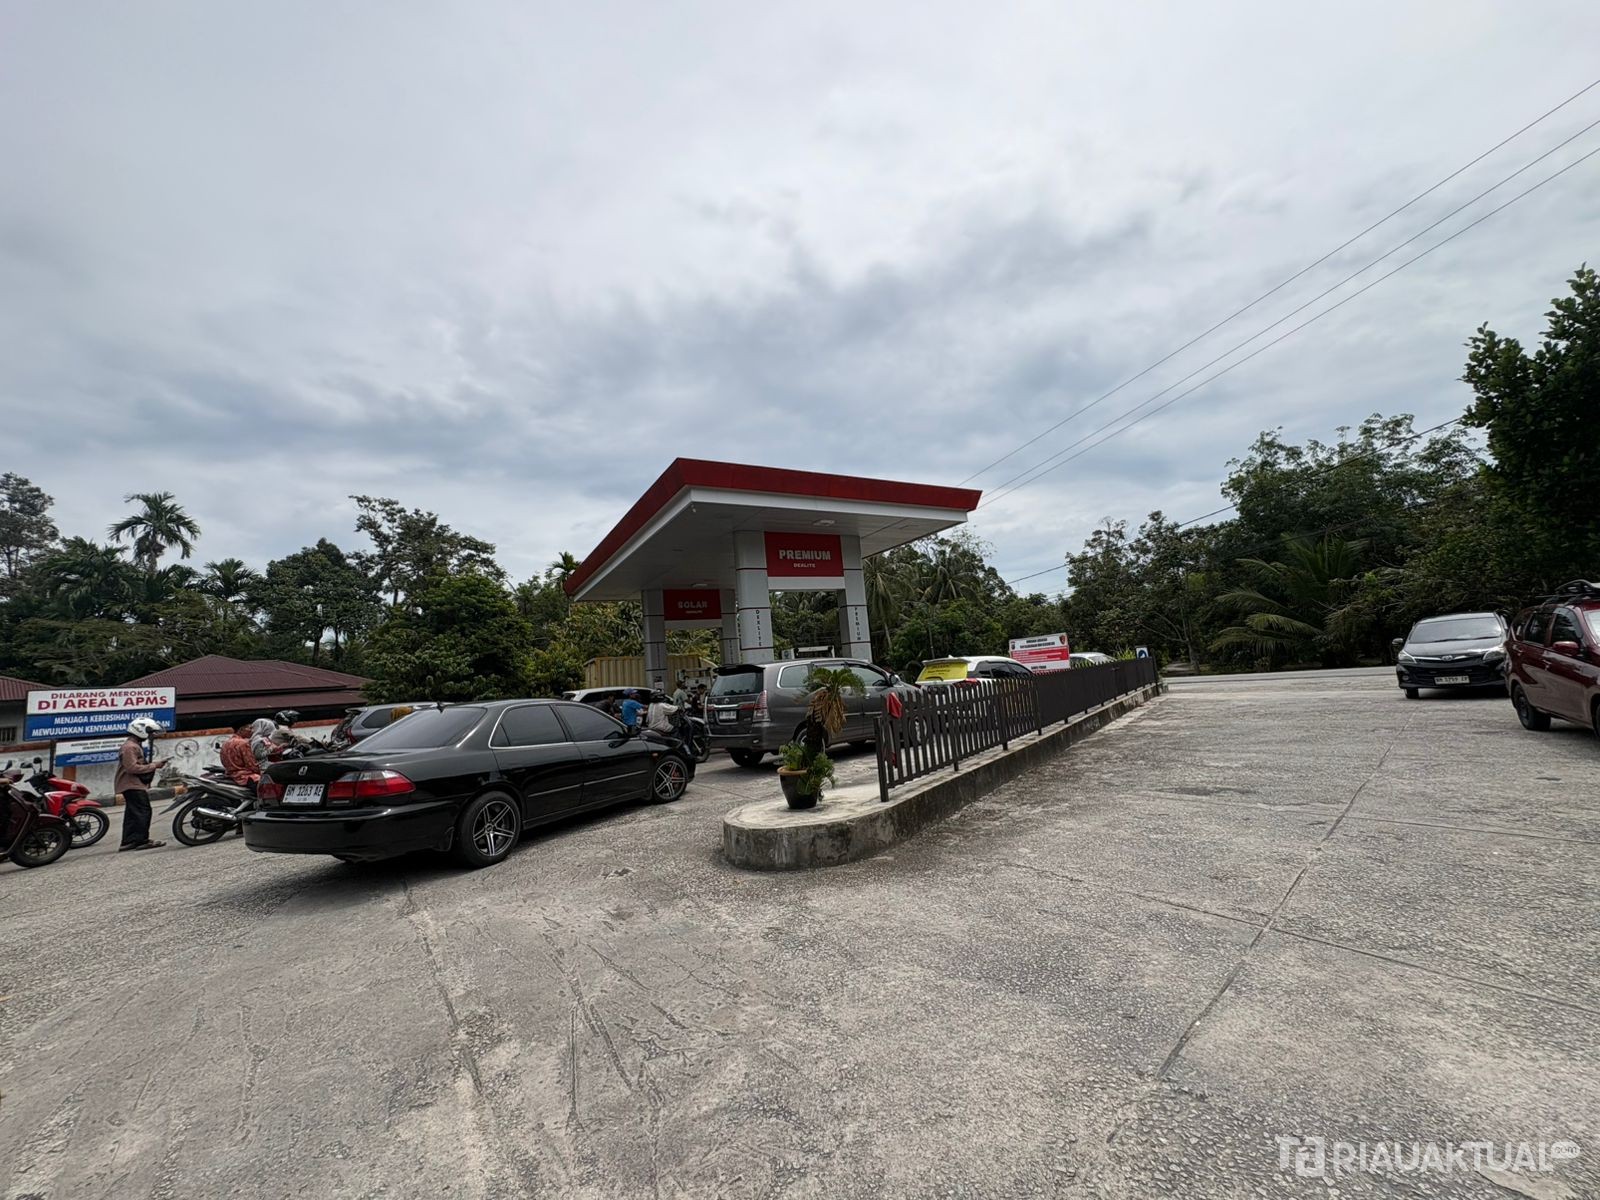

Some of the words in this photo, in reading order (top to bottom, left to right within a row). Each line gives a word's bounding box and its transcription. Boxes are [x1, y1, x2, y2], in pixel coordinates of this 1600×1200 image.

[778, 549, 831, 560] PREMIUM
[677, 600, 708, 609] SOLAR
[51, 691, 106, 700] DILARANG
[109, 689, 157, 698] MEROKOK
[37, 700, 57, 710] DI
[63, 697, 118, 709] AREAL
[123, 695, 167, 707] APMS
[54, 716, 88, 724] MENJAGA
[90, 713, 130, 723] KEBERSIHAN
[32, 726, 84, 736] MEWUJUDKAN
